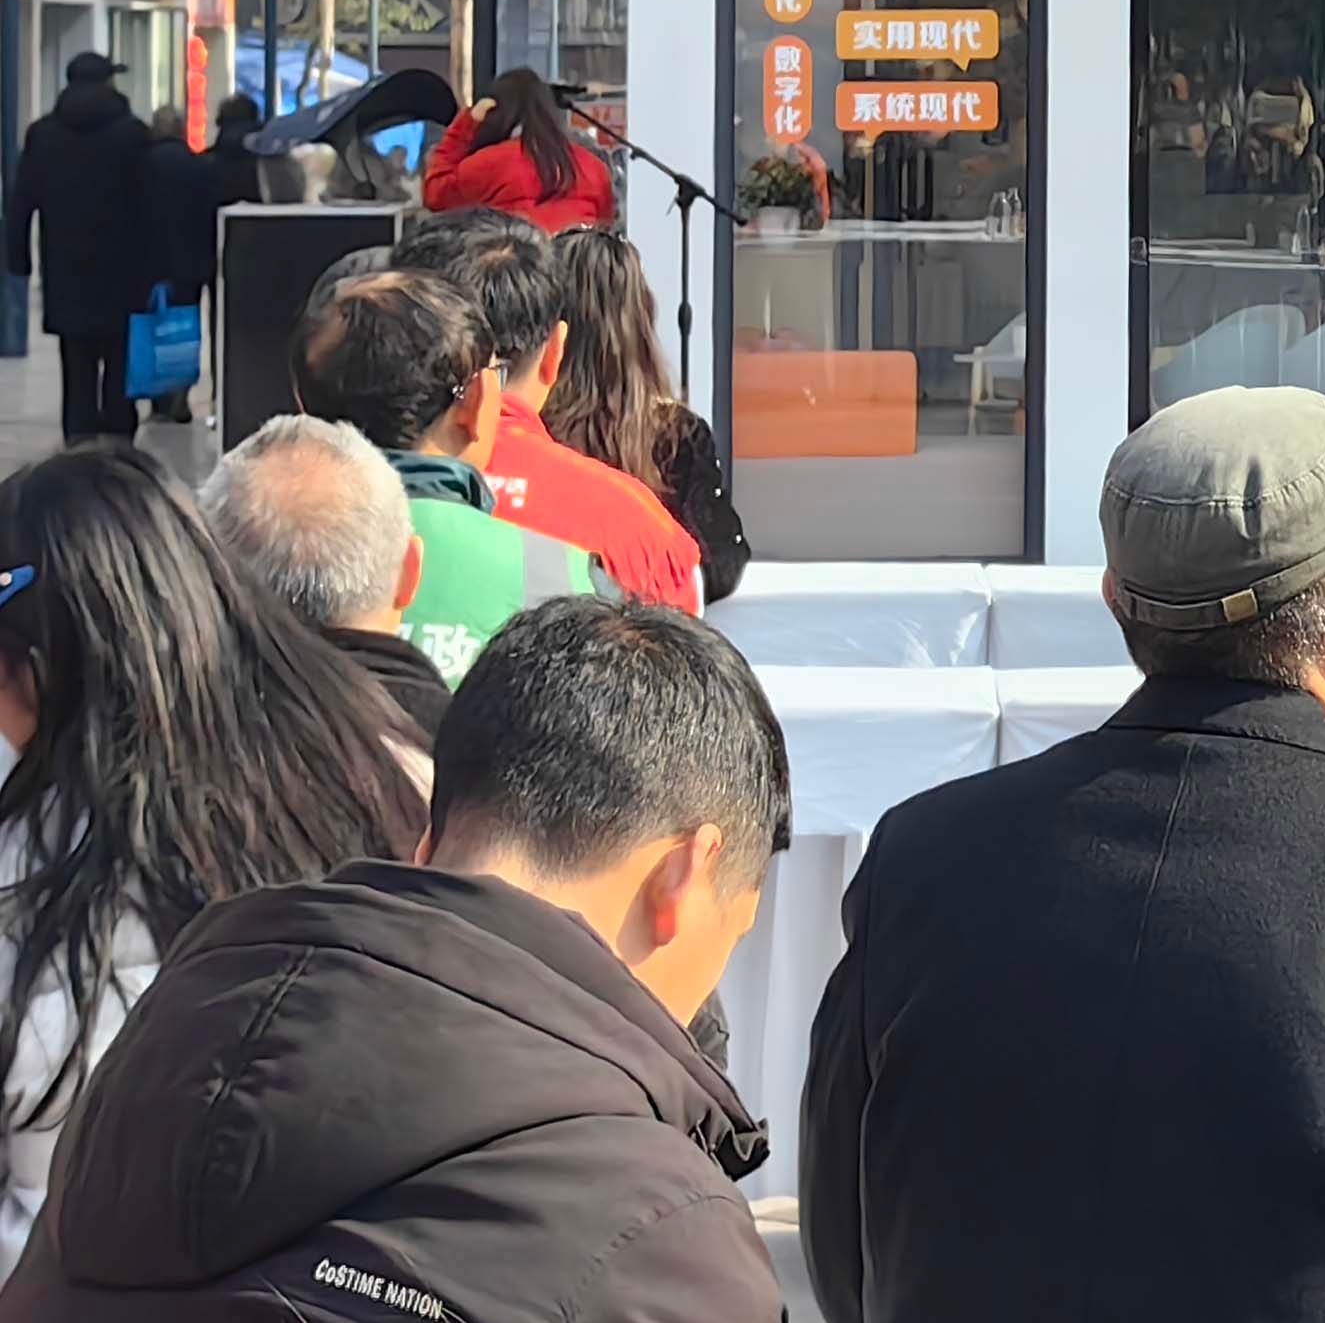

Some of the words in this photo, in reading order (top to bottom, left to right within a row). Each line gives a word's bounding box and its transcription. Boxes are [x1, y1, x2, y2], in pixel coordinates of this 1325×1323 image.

[853, 19, 983, 51] 实用现代
[774, 45, 803, 134] 数字化
[853, 92, 983, 123] 系统现代
[385, 1280, 442, 1322] NATION
